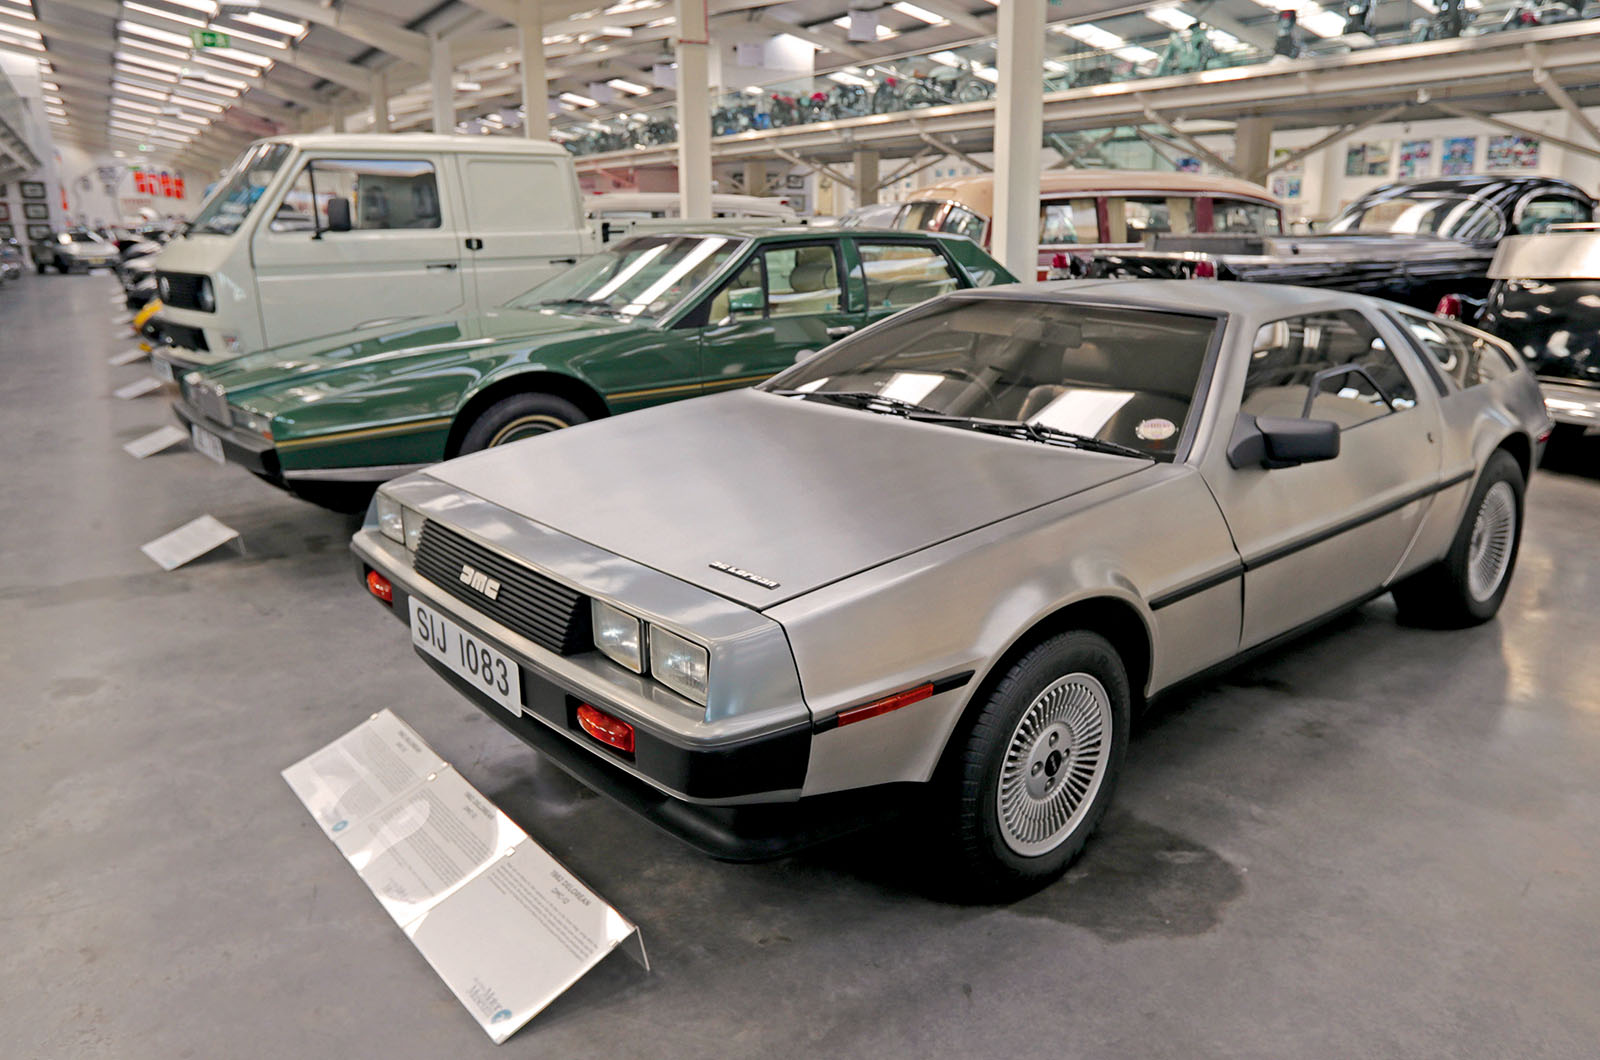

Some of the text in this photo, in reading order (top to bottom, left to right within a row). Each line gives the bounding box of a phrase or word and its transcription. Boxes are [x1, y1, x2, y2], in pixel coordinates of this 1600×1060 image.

[459, 564, 501, 600] DMC
[416, 607, 510, 697] SIJ 1083
